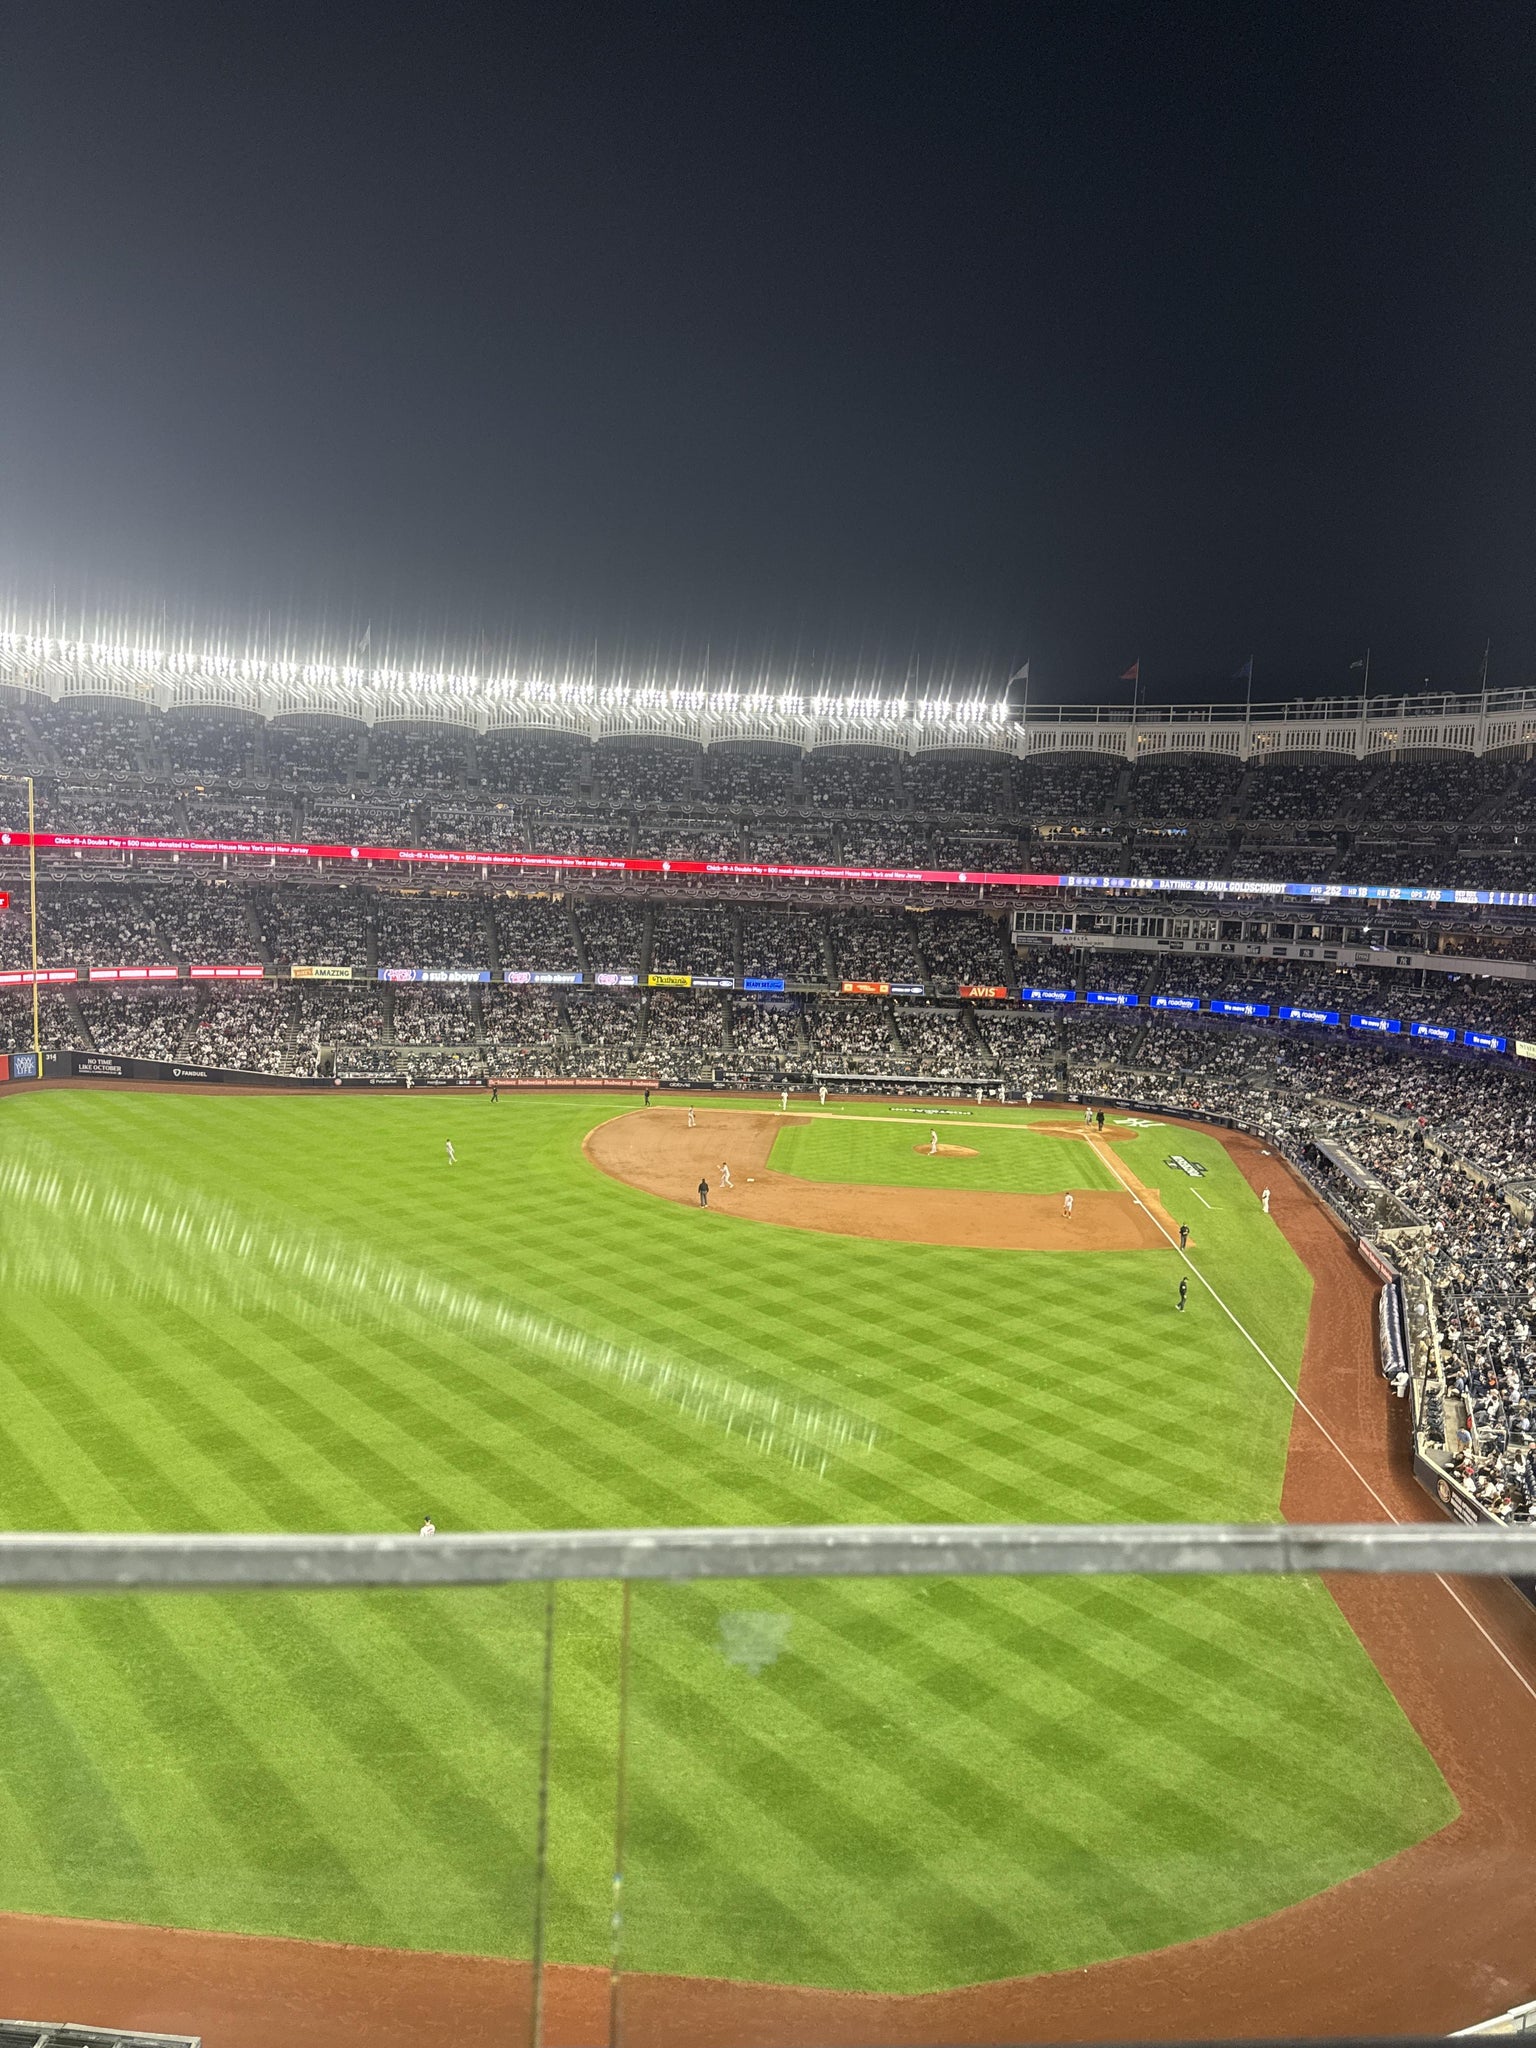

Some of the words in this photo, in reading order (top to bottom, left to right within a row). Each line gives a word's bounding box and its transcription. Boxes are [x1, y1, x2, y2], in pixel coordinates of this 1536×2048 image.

[109, 840, 121, 848] Play
[1068, 877, 1075, 886] B
[1103, 878, 1109, 887] S
[1160, 881, 1193, 889] BATTING:
[1207, 882, 1228, 891] PAUL
[1229, 883, 1286, 893] GOLDSCHMIDT
[430, 972, 448, 981] sub
[449, 972, 480, 981] above
[969, 988, 995, 997] AVIS
[1168, 1000, 1194, 1008] roadway
[1302, 1012, 1327, 1021] roadway
[1428, 1028, 1449, 1038] roadway
